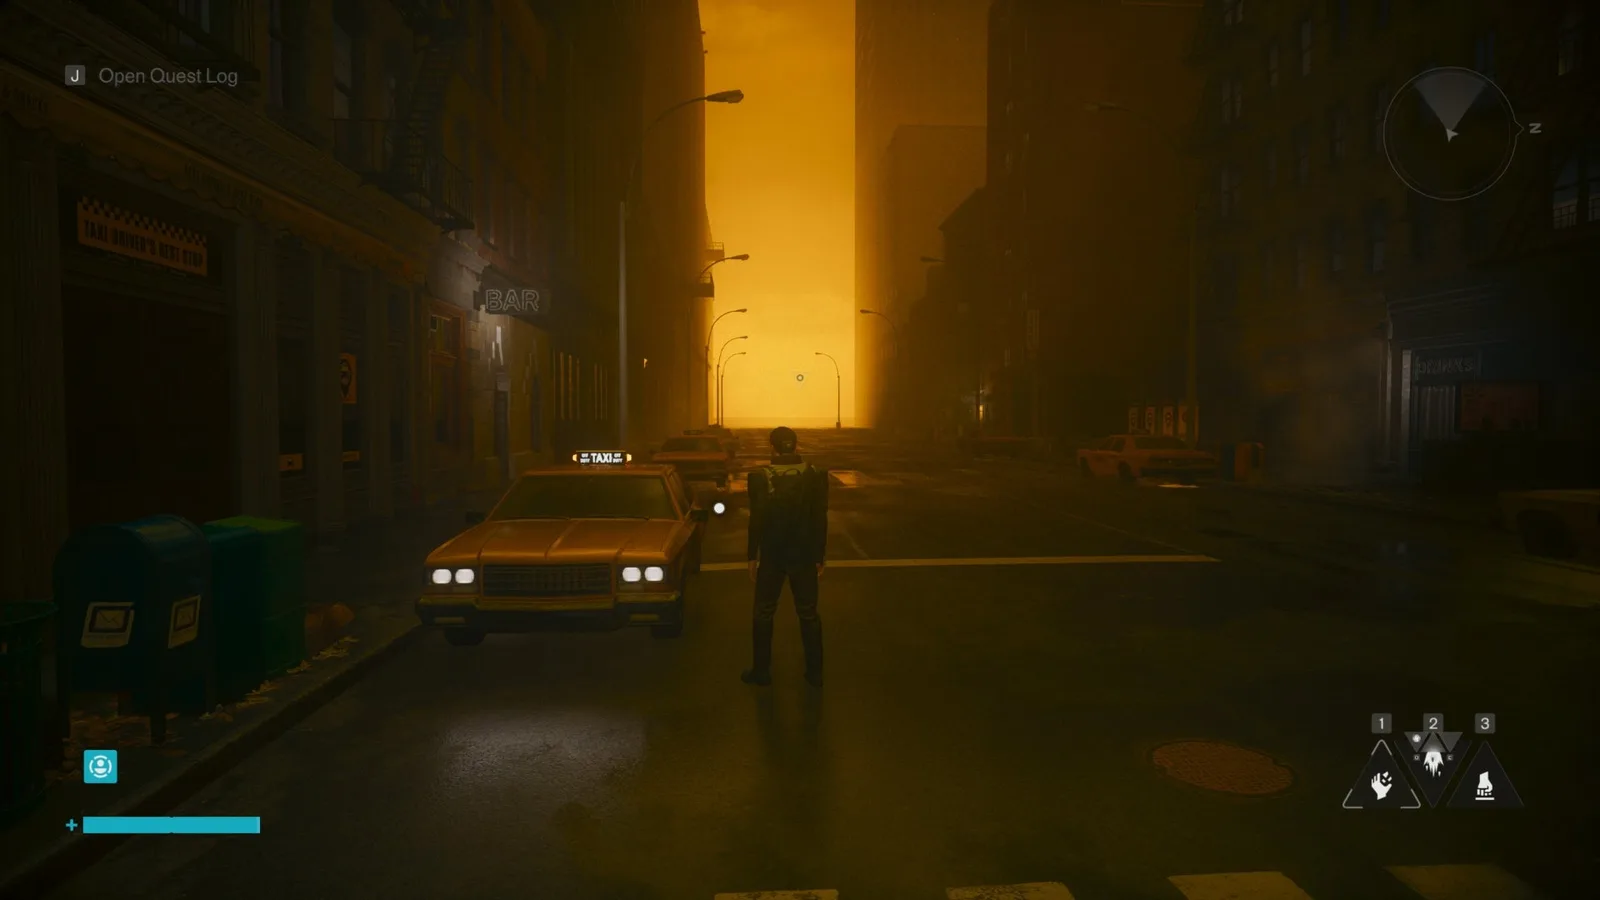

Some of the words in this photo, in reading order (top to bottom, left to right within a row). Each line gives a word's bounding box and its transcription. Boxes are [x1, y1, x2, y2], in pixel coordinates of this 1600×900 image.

[84, 219, 108, 243] TAXI
[485, 289, 540, 312] BAR
[590, 452, 613, 464] TAXI
